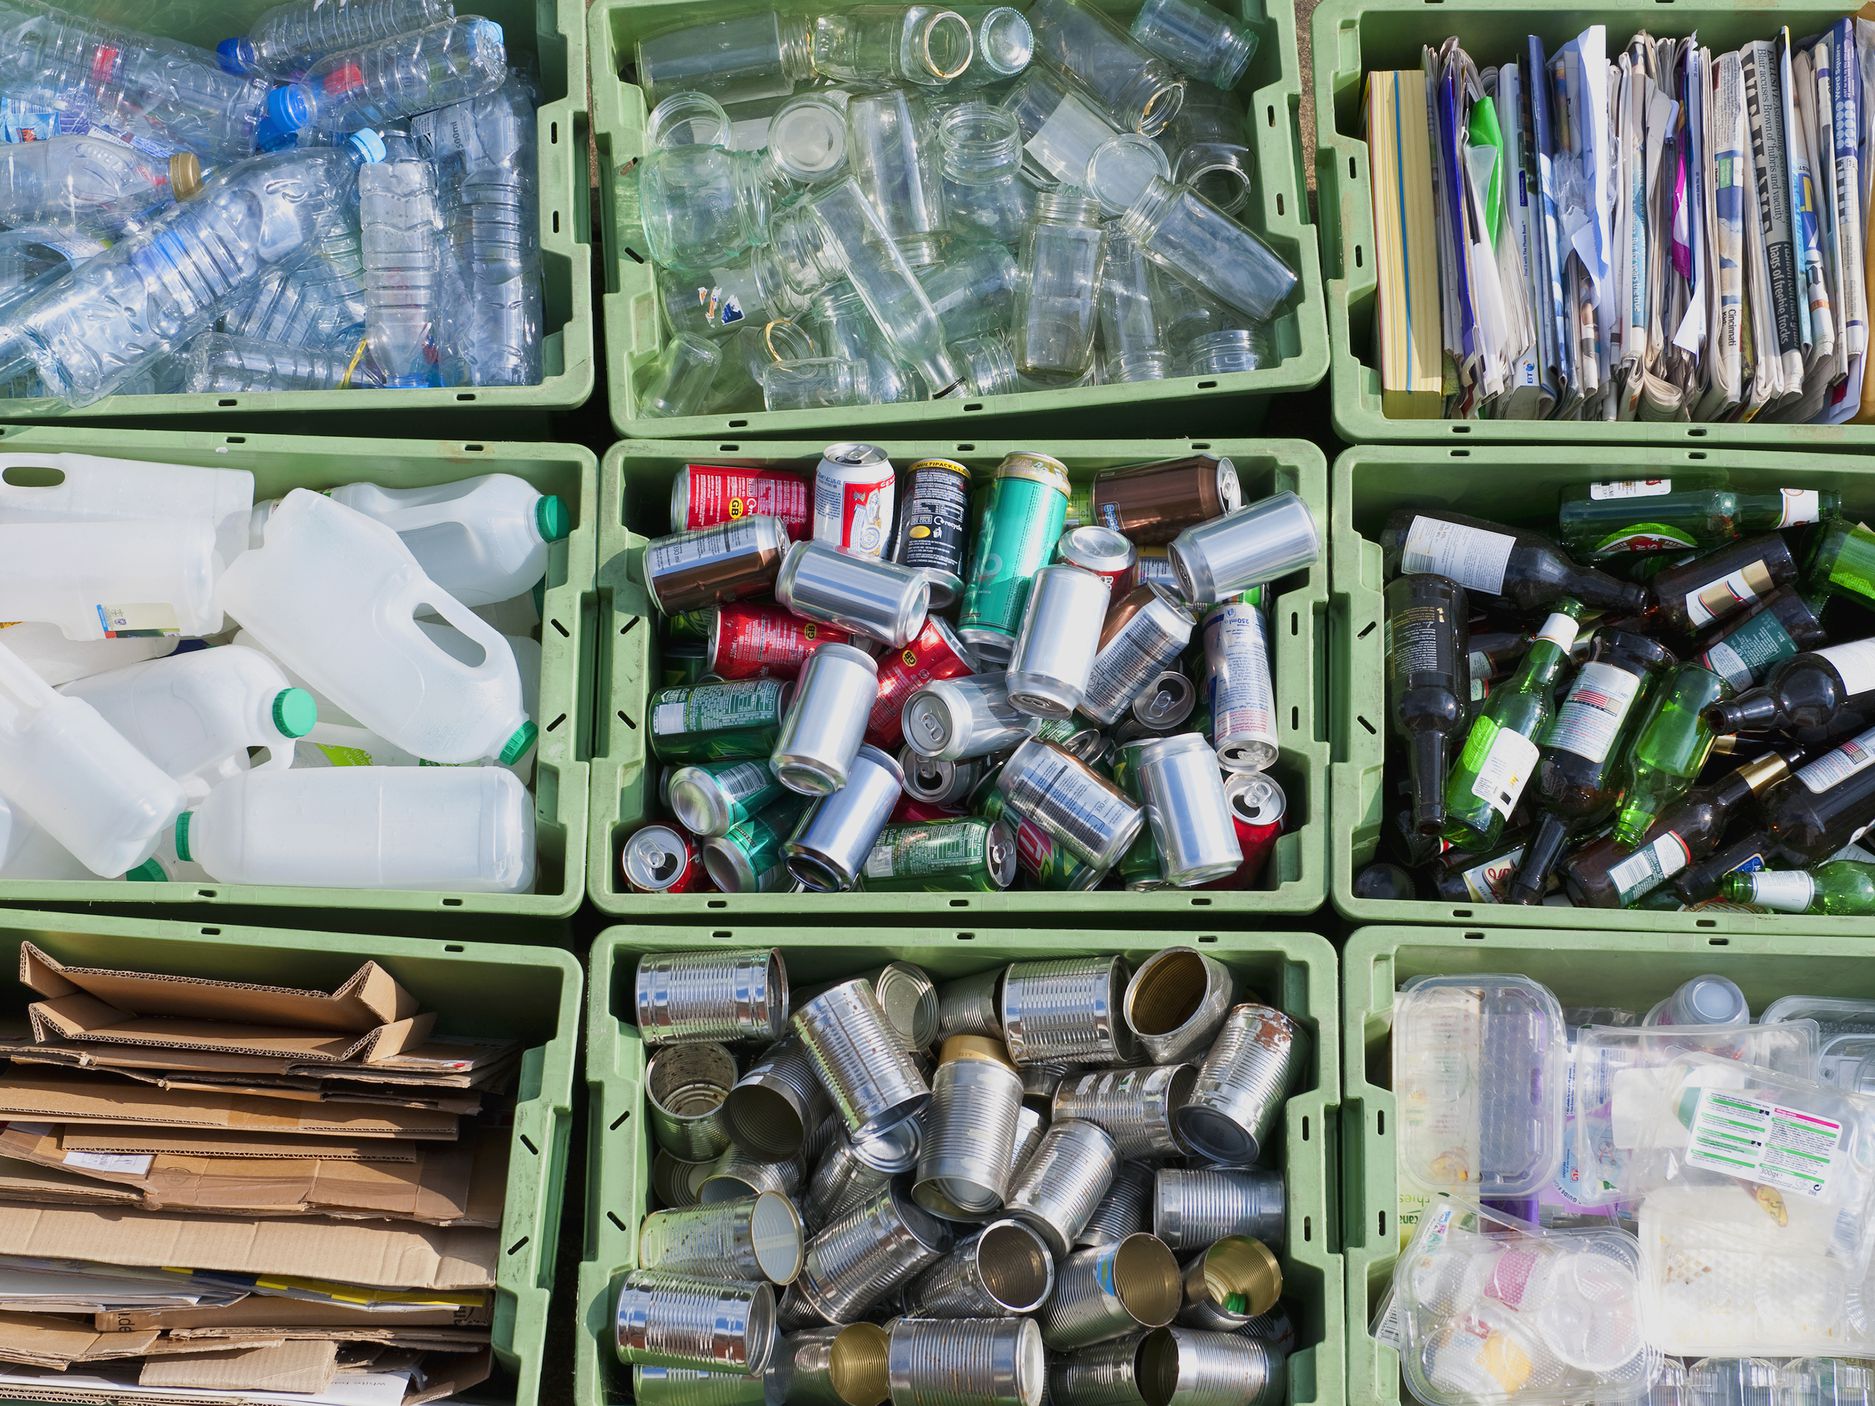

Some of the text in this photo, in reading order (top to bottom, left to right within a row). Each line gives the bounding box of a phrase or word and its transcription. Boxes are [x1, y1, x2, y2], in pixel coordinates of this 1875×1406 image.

[1757, 49, 1768, 69] Blair
[1760, 70, 1769, 102] accuses
[1763, 104, 1773, 131] Brown
[453, 121, 465, 151] 500ml
[1766, 133, 1776, 142] of
[1771, 174, 1780, 189] and
[1770, 245, 1790, 344] bags of freebie frocks
[1633, 296, 1641, 312] true
[1727, 309, 1737, 346] Cincinnati
[1526, 372, 1533, 383] BT
[730, 499, 739, 516] GB
[944, 518, 962, 533] recycle
[1229, 617, 1249, 625] 250ml
[806, 624, 815, 639] GB
[902, 650, 918, 665] GB
